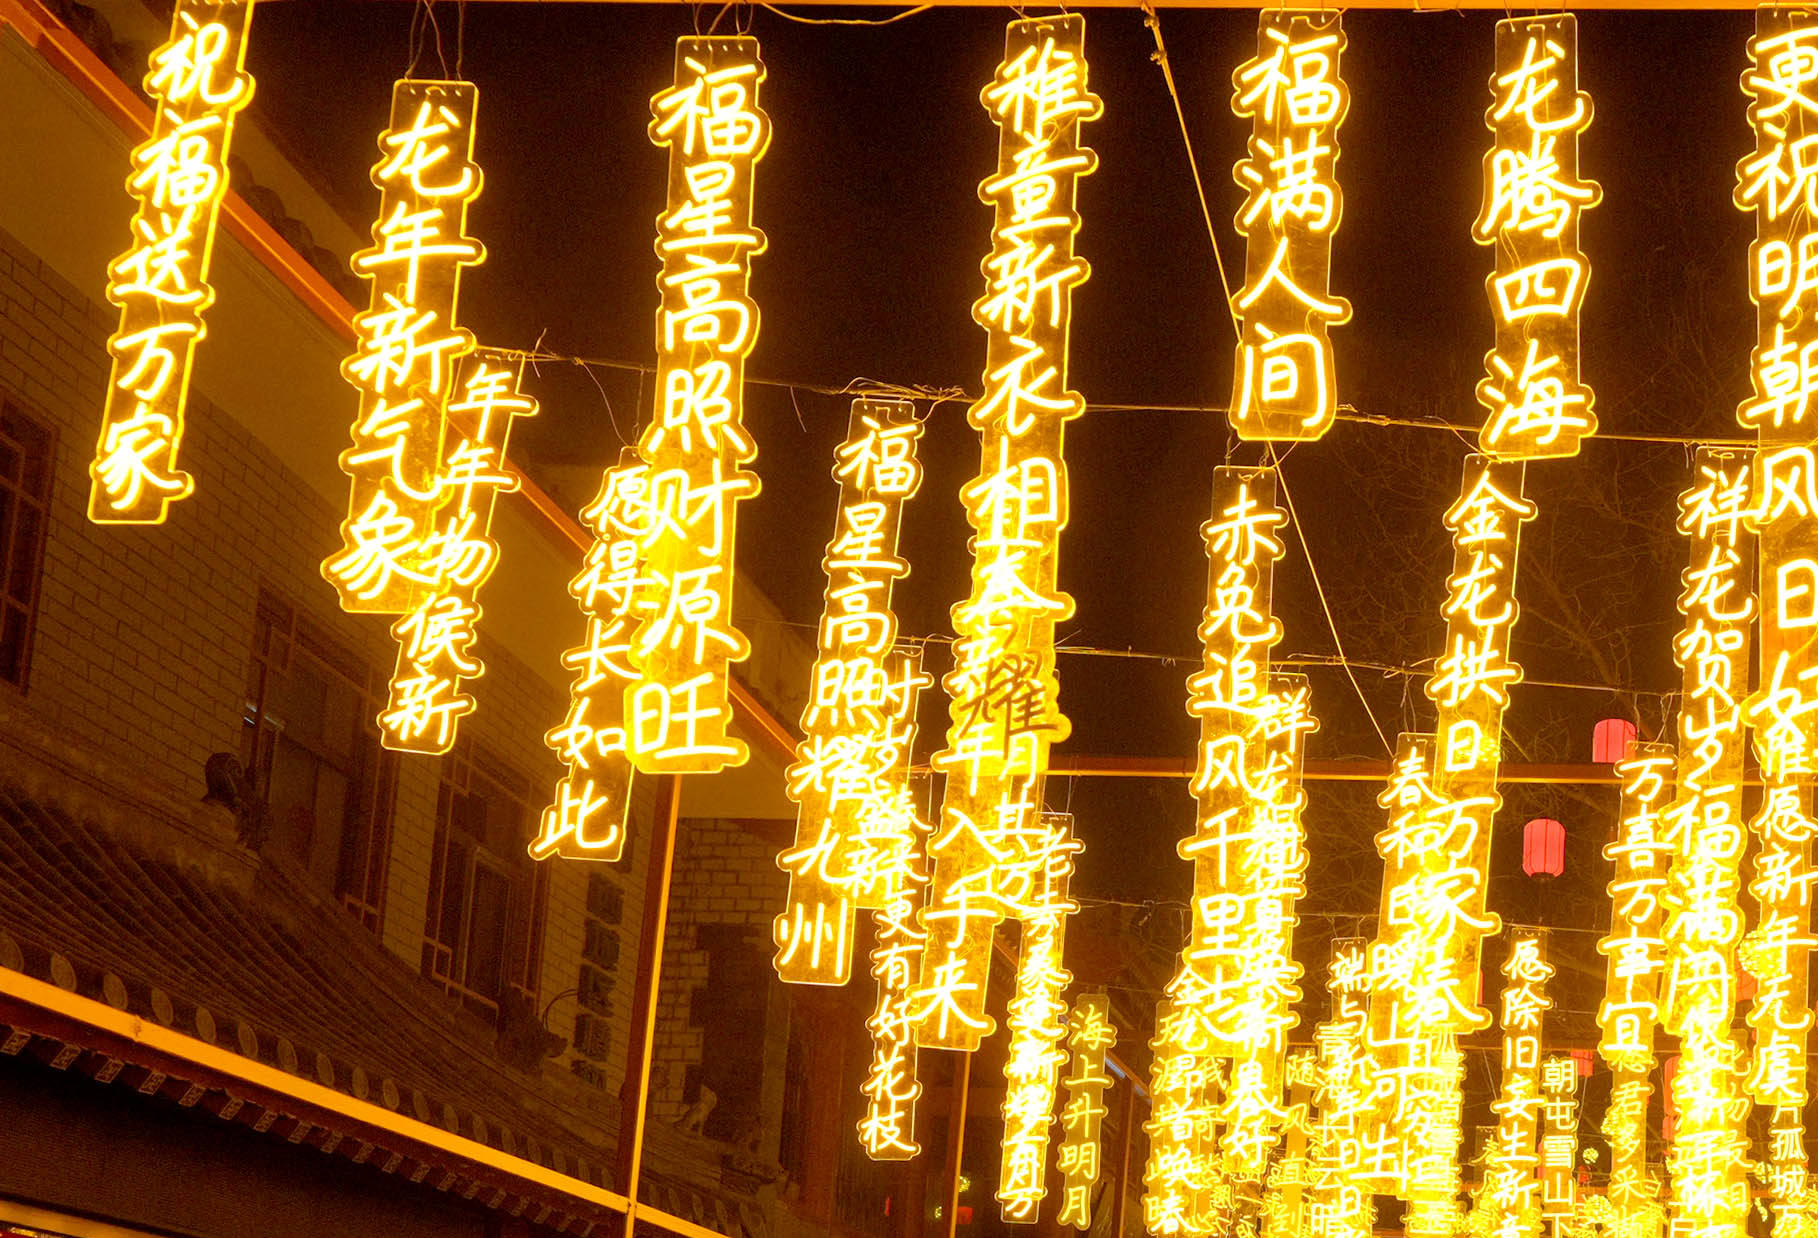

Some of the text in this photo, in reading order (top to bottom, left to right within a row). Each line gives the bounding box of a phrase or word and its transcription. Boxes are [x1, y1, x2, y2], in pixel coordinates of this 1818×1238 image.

[97, 20, 244, 509] 祝福送万家
[329, 103, 477, 599] 龙年新气象
[634, 58, 767, 757] 福星高照财源旺
[1239, 29, 1343, 427] 福满人间
[1481, 39, 1594, 445] 龙腾四海
[384, 365, 532, 743] 年年物候新
[1603, 758, 1676, 1051] 万喜万事宜
[1060, 1004, 1112, 1228] 海上升明月
